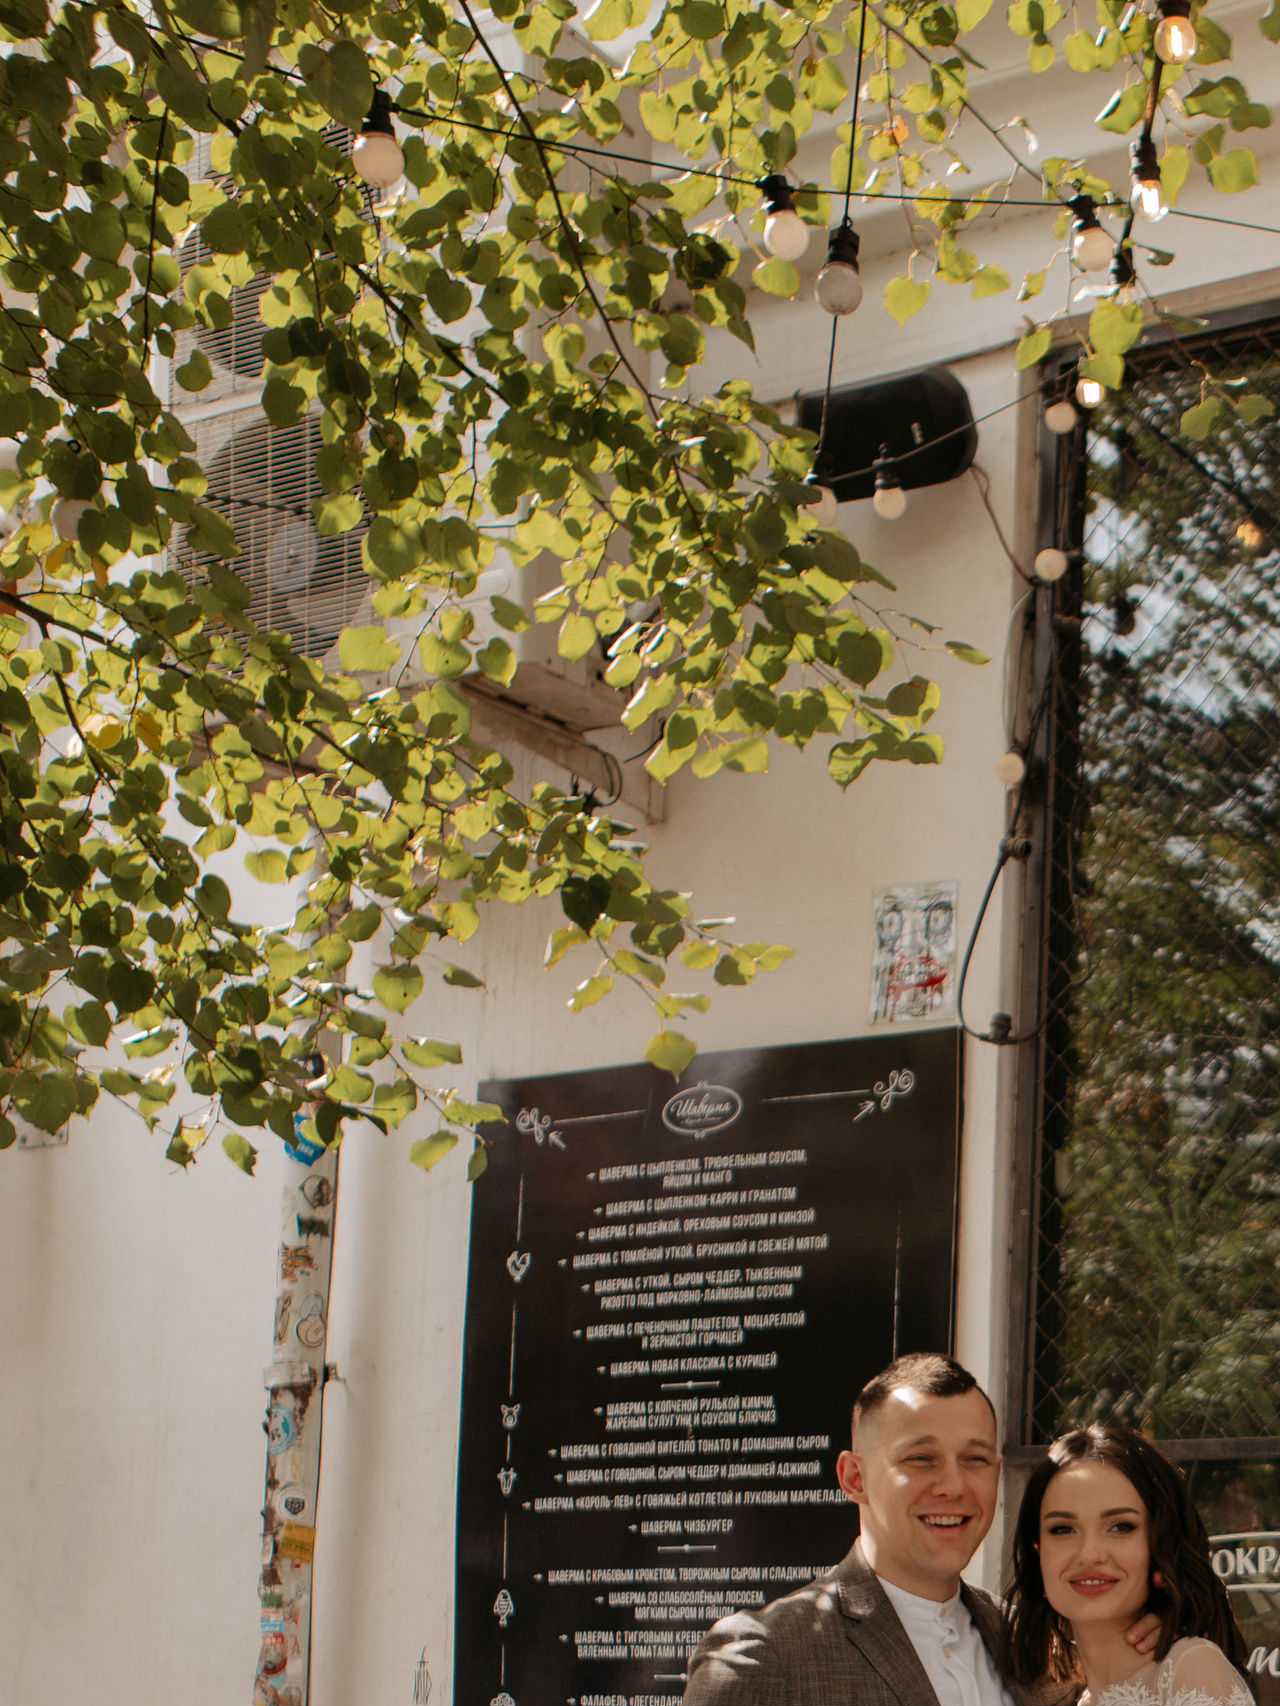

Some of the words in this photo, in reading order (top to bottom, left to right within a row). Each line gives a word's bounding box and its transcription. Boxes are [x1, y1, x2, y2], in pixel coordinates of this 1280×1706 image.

[599, 1165, 637, 1181] ШАВЕРМА
[639, 1165, 645, 1178] С
[704, 1153, 766, 1172] ТРЮФЕЛЬНЫМ
[663, 1173, 692, 1189] ЯЙЦОМ
[694, 1172, 700, 1186] И
[702, 1170, 732, 1185] МАНГО
[606, 1200, 645, 1216] ШАВЕРМА
[647, 1200, 652, 1213] С
[740, 1192, 746, 1205] И
[748, 1187, 796, 1204] ГРАНАТОМ
[588, 1225, 626, 1240] ШАВЕРМА
[628, 1224, 634, 1237] С
[684, 1216, 730, 1233] ОРЕХОВЫМ
[732, 1213, 767, 1229] СОУСОМ
[770, 1213, 776, 1226] И
[778, 1209, 815, 1225] КИНЗОЙ
[573, 1253, 611, 1268] ШАВЕРМА
[613, 1252, 619, 1265] С
[697, 1242, 747, 1259] БРУСНИКОЙ
[749, 1241, 755, 1255] И
[757, 1238, 795, 1254] СВЕЖЕЙ
[797, 1235, 827, 1251] МЯТОЙ
[594, 1278, 633, 1293] ШАВЕРМА
[635, 1278, 641, 1290] С
[673, 1273, 703, 1288] СЫРОМ
[745, 1266, 802, 1282] ТЫКВЕННЫМ
[601, 1295, 635, 1310] РИЗОТТО
[637, 1293, 654, 1307] ПОД
[756, 1284, 792, 1299] СОУСОМ
[586, 1323, 624, 1339] ШАВЕРМА
[626, 1323, 632, 1337] С
[634, 1319, 689, 1336] ПЕЧЕНОЧНЫМ
[744, 1311, 805, 1329] МОЦАРЕЛЛОЙ
[642, 1336, 648, 1349] И
[649, 1332, 697, 1348] ЗЕРНИСТОЙ
[699, 1329, 743, 1345] ГОРЧИЦЕЙ
[610, 1360, 649, 1376] ШАВЕРМА
[651, 1358, 678, 1373] НОВАЯ
[680, 1355, 725, 1372] КЛАССИКА
[728, 1355, 733, 1369] С
[736, 1352, 777, 1369] КУРИЦЕЙ
[607, 1402, 646, 1415] ШАВЕРМА
[648, 1401, 653, 1414] С
[700, 1397, 739, 1411] РУЛЬКОЙ
[606, 1415, 646, 1431] ЖАРЕНЫМ
[694, 1413, 699, 1427] И
[702, 1411, 736, 1426] СОУСОМ
[739, 1410, 776, 1425] БЛЮЧИЗ
[560, 1444, 600, 1459] ШАВЕРМА
[601, 1443, 607, 1457] С
[608, 1441, 656, 1457] ГОВЯДИНОЙ
[657, 1440, 696, 1455] ВИТЕЛЛО
[697, 1439, 730, 1453] ТОНАТО
[732, 1438, 739, 1452] И
[741, 1436, 794, 1452] ДОМАШНИМ
[796, 1435, 830, 1449] СЫРОМ
[566, 1469, 603, 1484] ШАВЕРМА
[604, 1468, 610, 1483] С
[658, 1465, 686, 1480] СЫРОМ
[687, 1464, 719, 1479] ЧЕДДЕР
[720, 1464, 727, 1478] И
[728, 1462, 775, 1478] ДОМАШНЕЙ
[777, 1460, 820, 1476] АДЖИКОЙ
[534, 1496, 574, 1512] ШАВЕРМА
[635, 1494, 641, 1509] С
[643, 1493, 687, 1509] ГОВЯЖЬЕЙ
[689, 1491, 734, 1507] КОТЛЕТОЙ
[735, 1491, 741, 1506] И
[744, 1490, 788, 1505] ЛУКОВЫМ
[790, 1488, 852, 1504] МАРМЕЛАДО
[641, 1520, 682, 1535] ШАВЕРМА
[684, 1519, 733, 1534] ЧИЗБУРГЕР
[548, 1569, 584, 1583] ШАВЕРМА
[586, 1569, 591, 1582] С
[592, 1568, 633, 1582] КРАБОВЫМ
[679, 1567, 730, 1581] ТВОРОЖНЫМ
[731, 1567, 761, 1580] СЫРОМ
[762, 1567, 768, 1579] И
[770, 1566, 812, 1579] СЛАДКИМ
[608, 1592, 646, 1604] ШАВЕРМА
[648, 1592, 658, 1604] СО
[634, 1606, 667, 1619] МЯГКИМ
[668, 1606, 697, 1619] СЫРОМ
[698, 1606, 704, 1618] И
[705, 1605, 735, 1618] ЯЙЦОМ
[575, 1631, 614, 1644] ШАВЕРМА
[616, 1631, 621, 1644] С
[624, 1631, 673, 1644] ТИГРОВЫМИ
[578, 1645, 627, 1657] ВЯЛЕННЫМИ
[630, 1645, 675, 1657] ТОМАТАМИ
[678, 1645, 683, 1657] И
